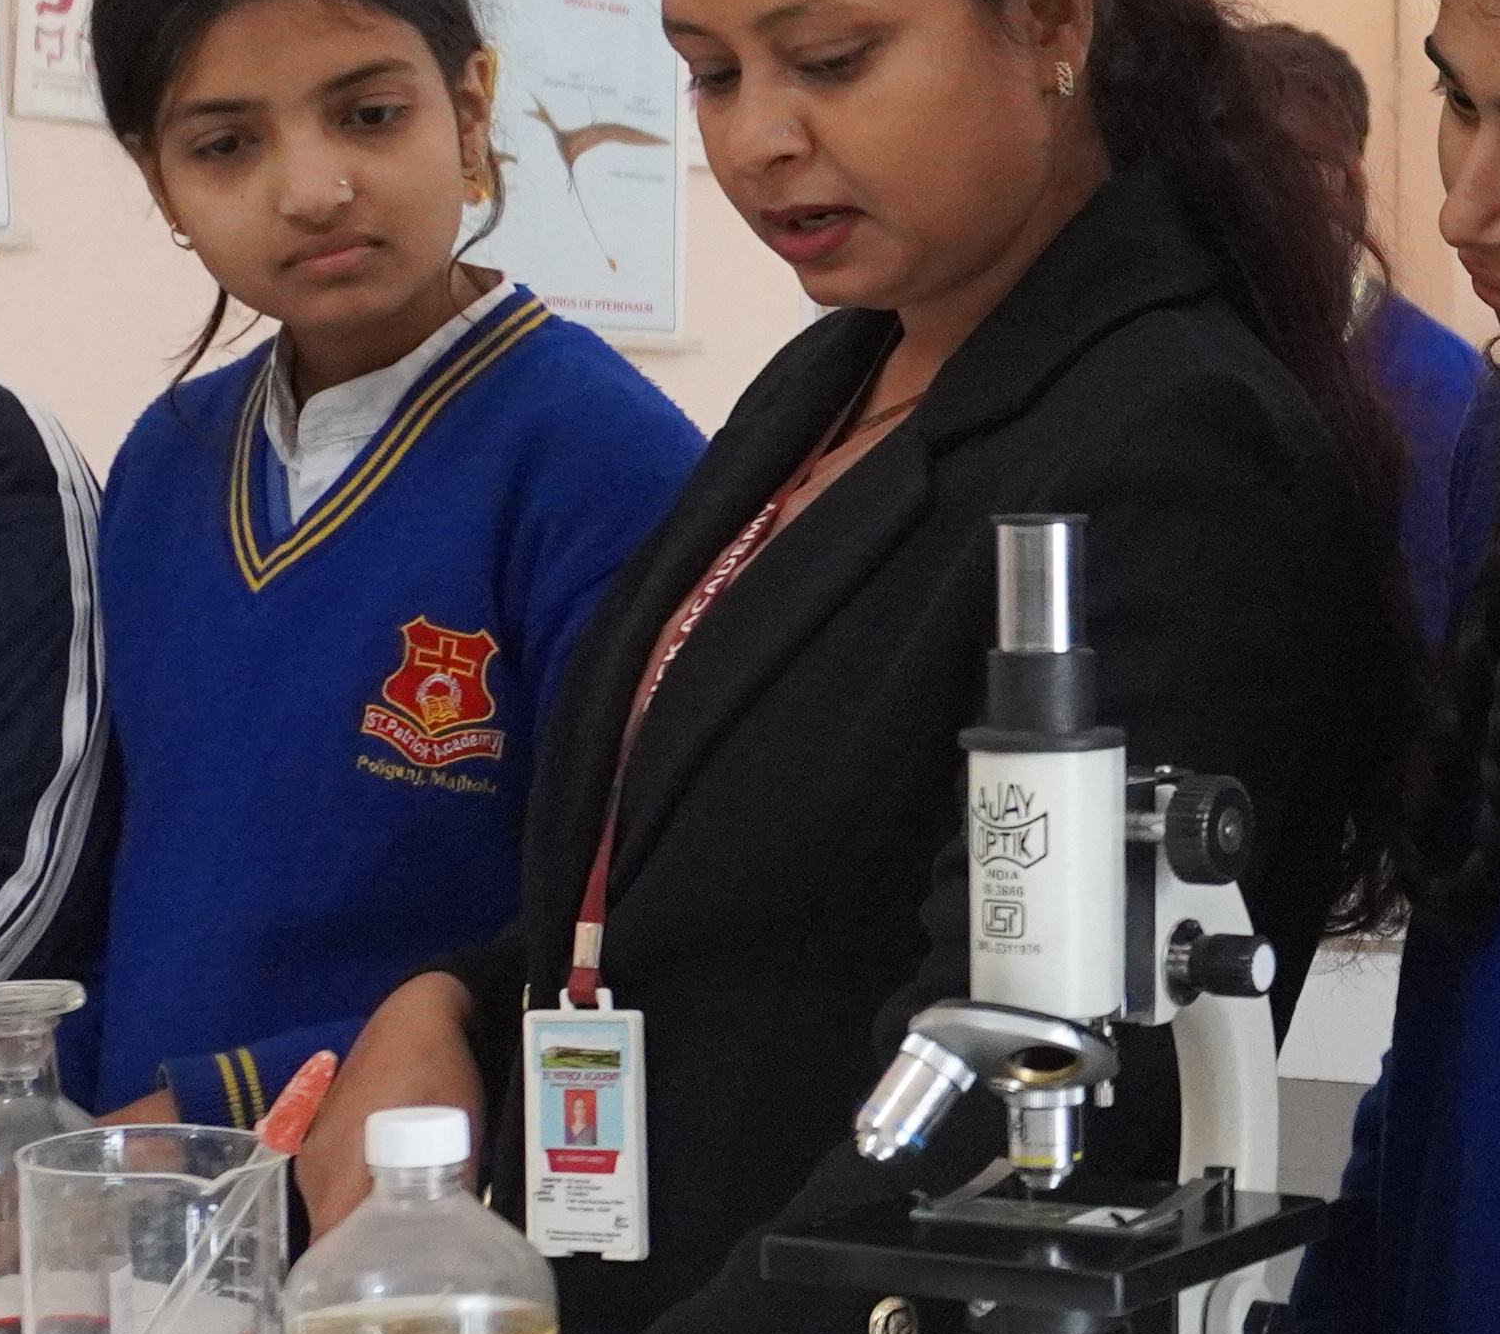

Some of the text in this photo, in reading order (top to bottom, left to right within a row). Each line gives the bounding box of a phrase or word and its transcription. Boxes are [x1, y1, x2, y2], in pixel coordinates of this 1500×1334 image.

[544, 296, 653, 315] WINGS OF PTEROSAUR
[679, 502, 777, 633] ACADEMY
[975, 782, 1035, 861] AJAY OPTIK
